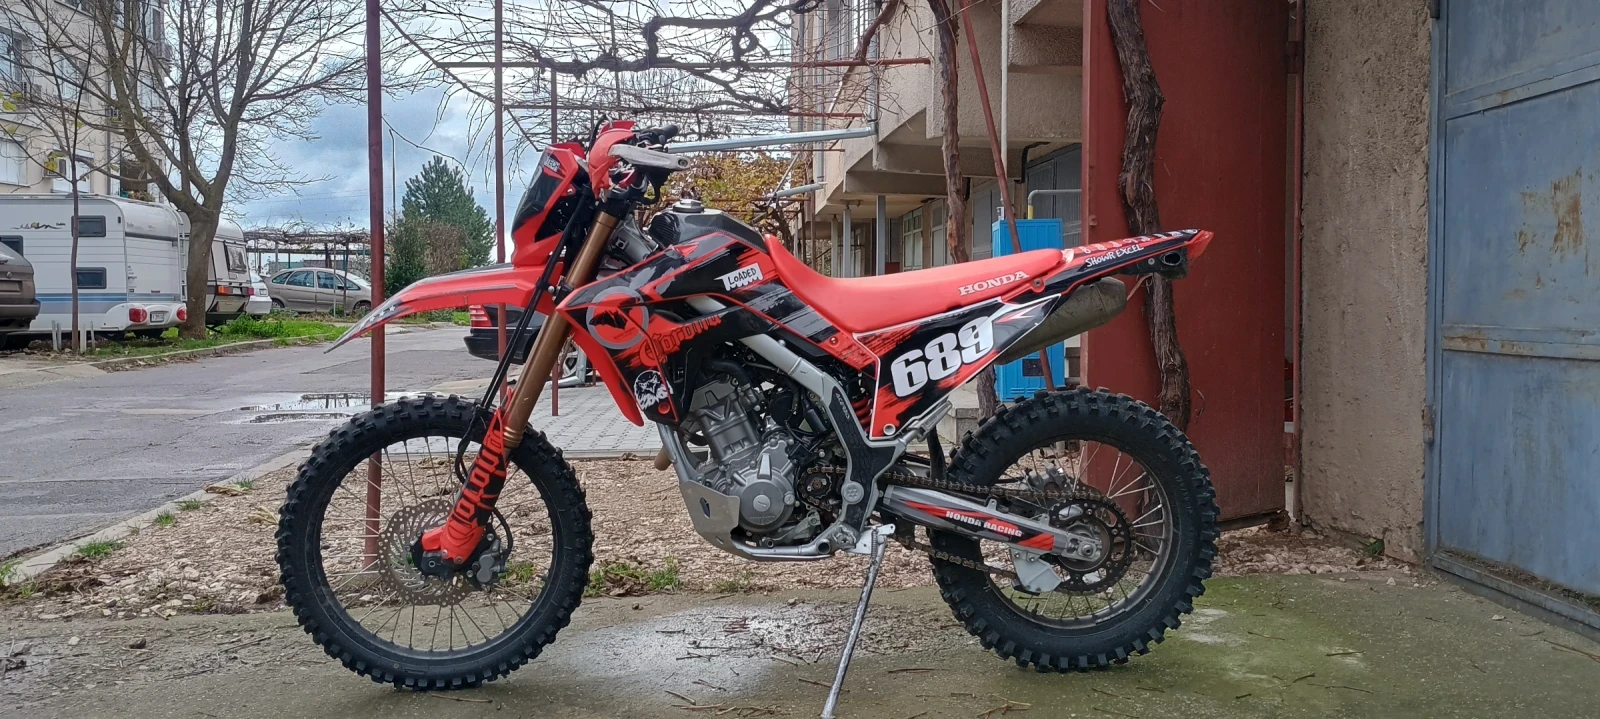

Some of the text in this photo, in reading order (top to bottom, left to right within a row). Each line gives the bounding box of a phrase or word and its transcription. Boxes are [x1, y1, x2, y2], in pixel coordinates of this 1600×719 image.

[1085, 243, 1144, 268] SHOWR EXCEL
[958, 271, 1030, 297] HONDA
[890, 316, 994, 398] 689
[945, 510, 1023, 538] HONDA RACING
